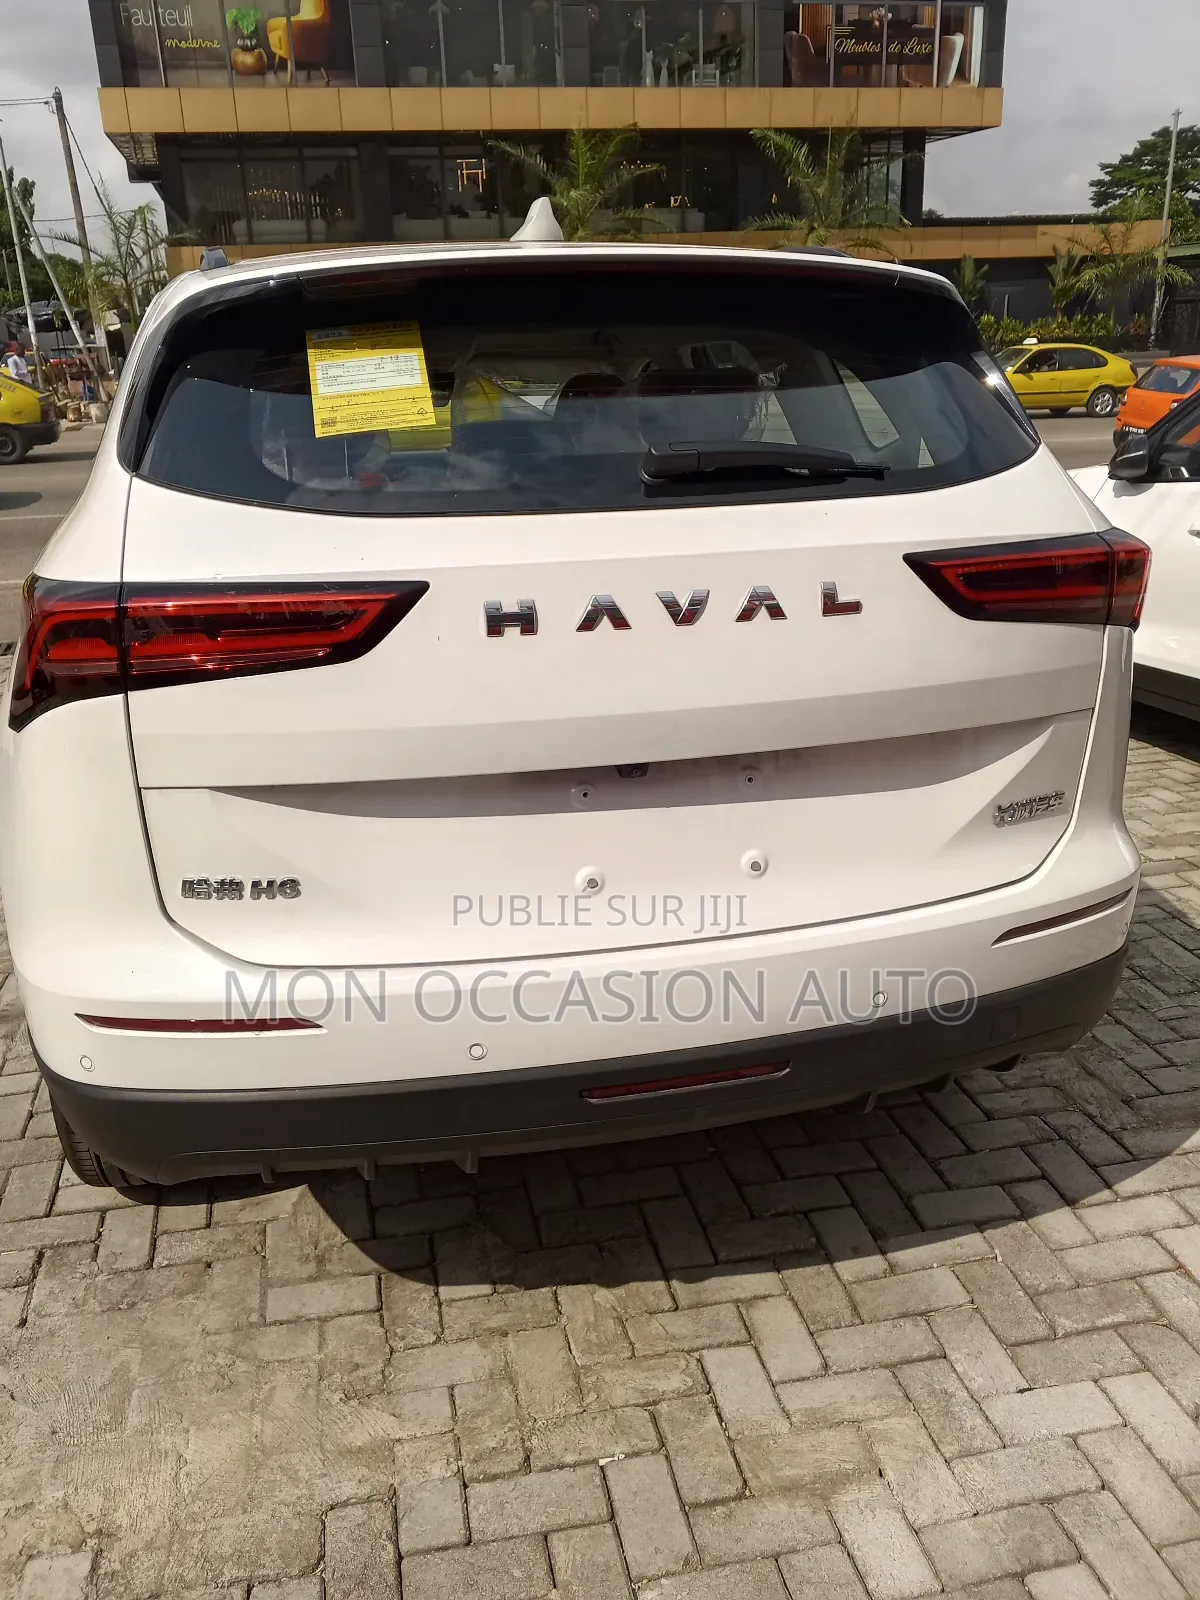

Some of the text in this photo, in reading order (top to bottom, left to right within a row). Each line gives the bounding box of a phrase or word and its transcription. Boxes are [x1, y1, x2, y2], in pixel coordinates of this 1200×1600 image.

[120, 2, 193, 27] Fauteuil
[165, 31, 220, 48] moderne
[834, 37, 933, 55] Meubles de Luxe
[483, 580, 864, 638] HAVAL
[249, 876, 302, 901] H6
